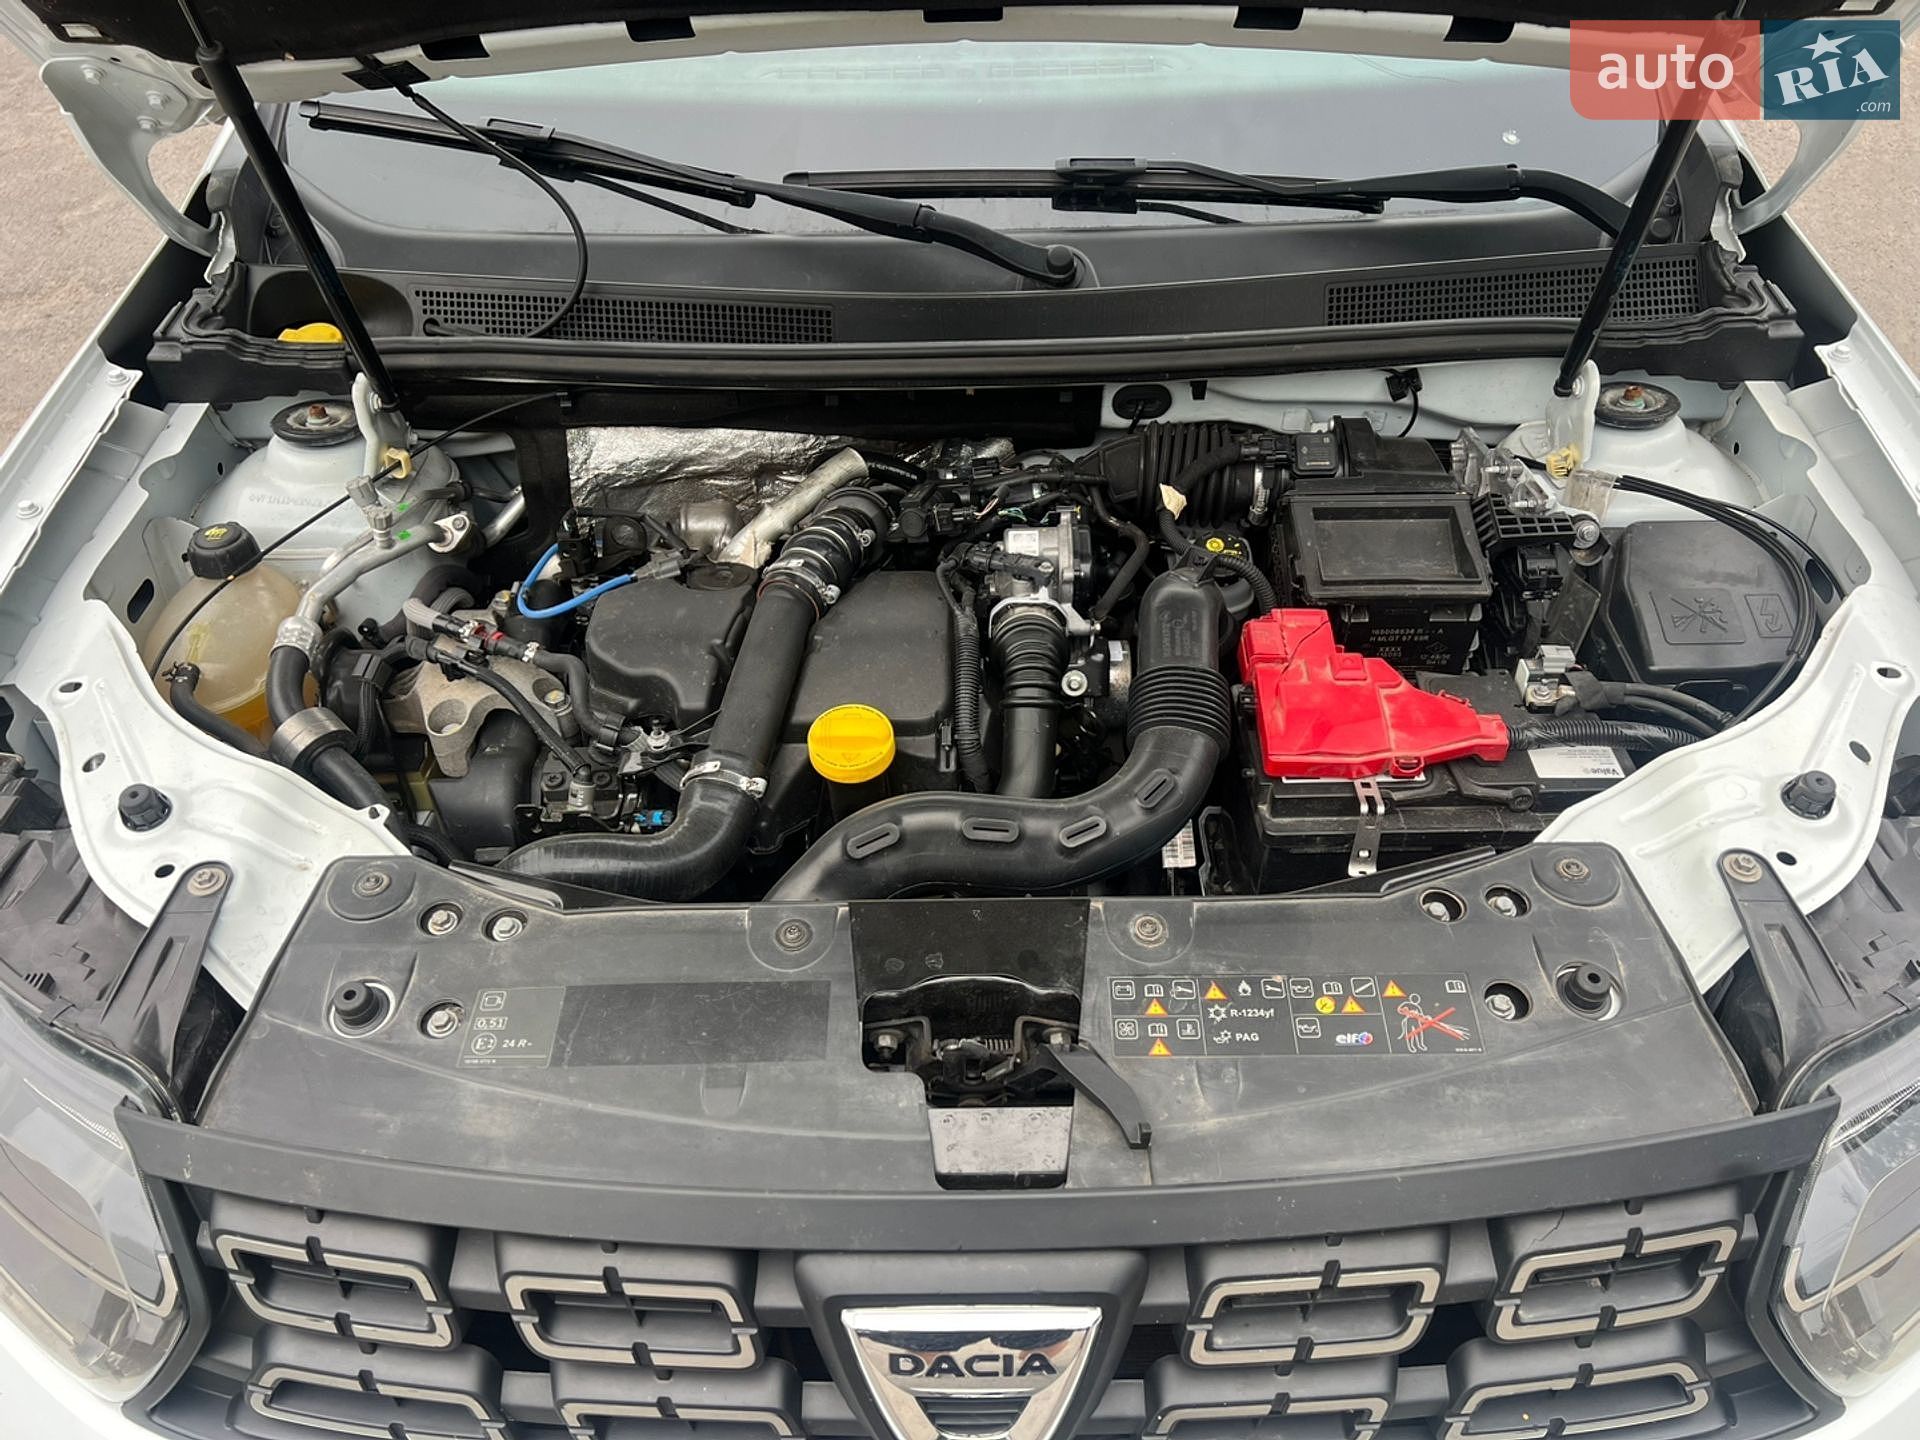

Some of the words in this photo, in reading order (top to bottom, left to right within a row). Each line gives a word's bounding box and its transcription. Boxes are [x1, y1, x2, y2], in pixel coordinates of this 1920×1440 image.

[1230, 1008, 1275, 1019] R-1234yf
[1235, 1032, 1260, 1042] PAG
[502, 1039, 515, 1048] 24
[889, 1352, 1057, 1378] DACIA
